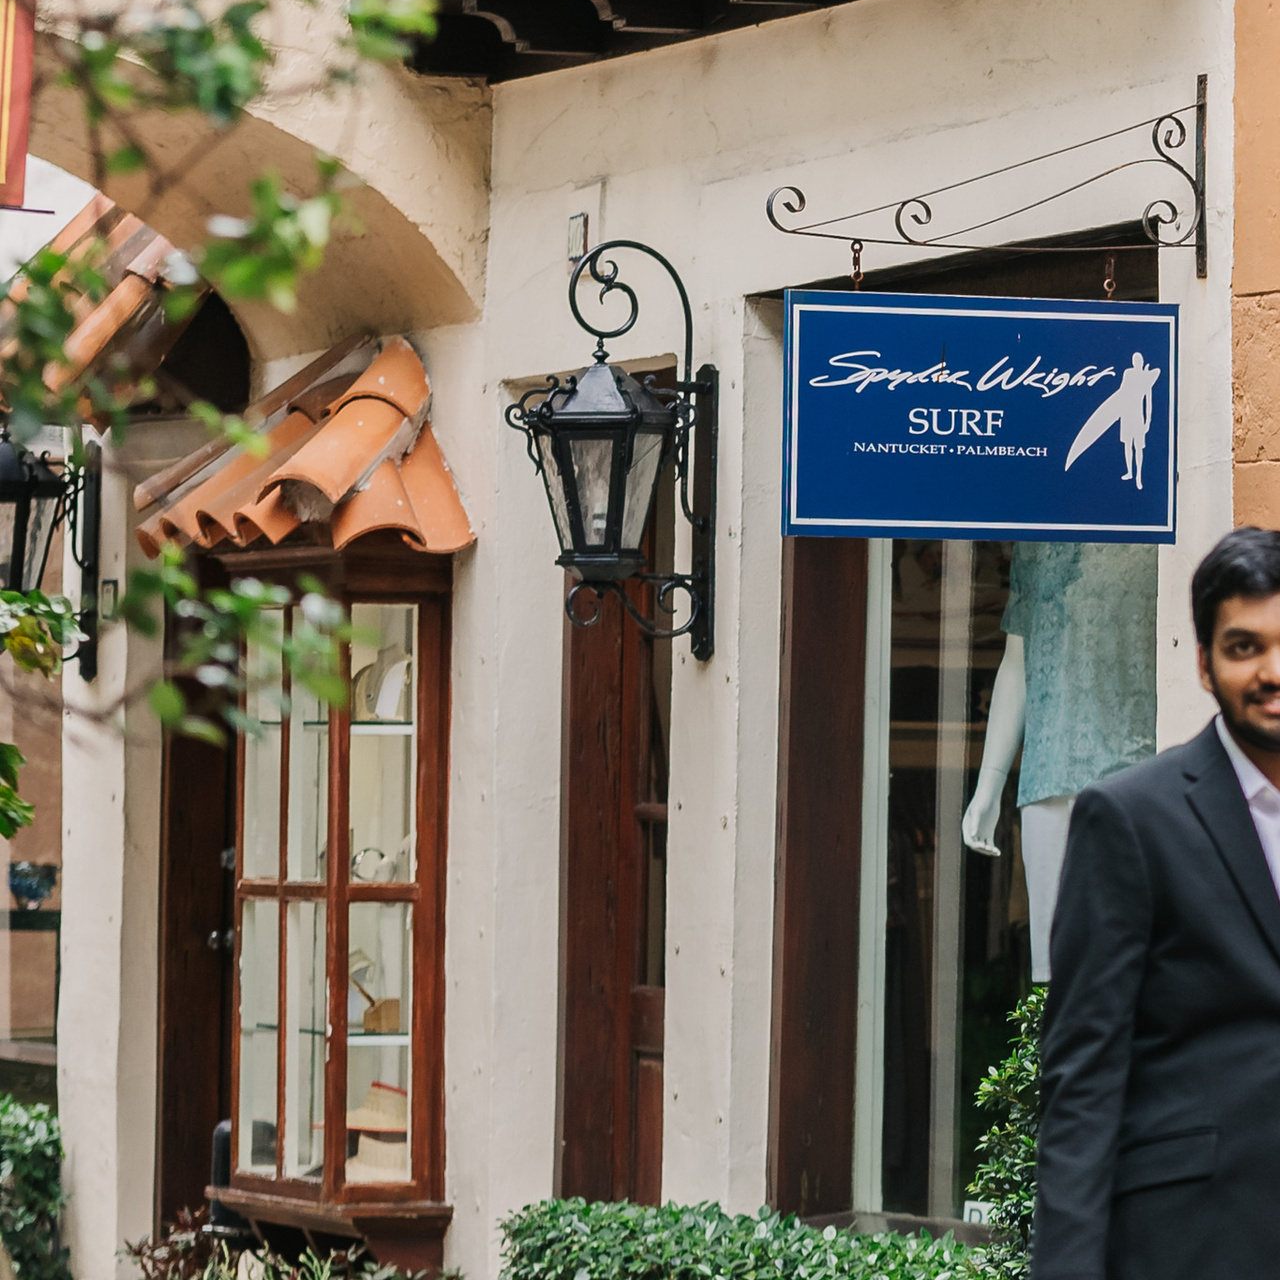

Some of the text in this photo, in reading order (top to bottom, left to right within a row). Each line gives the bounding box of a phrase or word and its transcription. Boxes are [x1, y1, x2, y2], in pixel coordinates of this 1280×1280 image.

[808, 350, 1116, 398] Spyder Wright
[908, 407, 1004, 437] SURF
[853, 441, 1048, 457] NANTUCKET PALMBEACH
